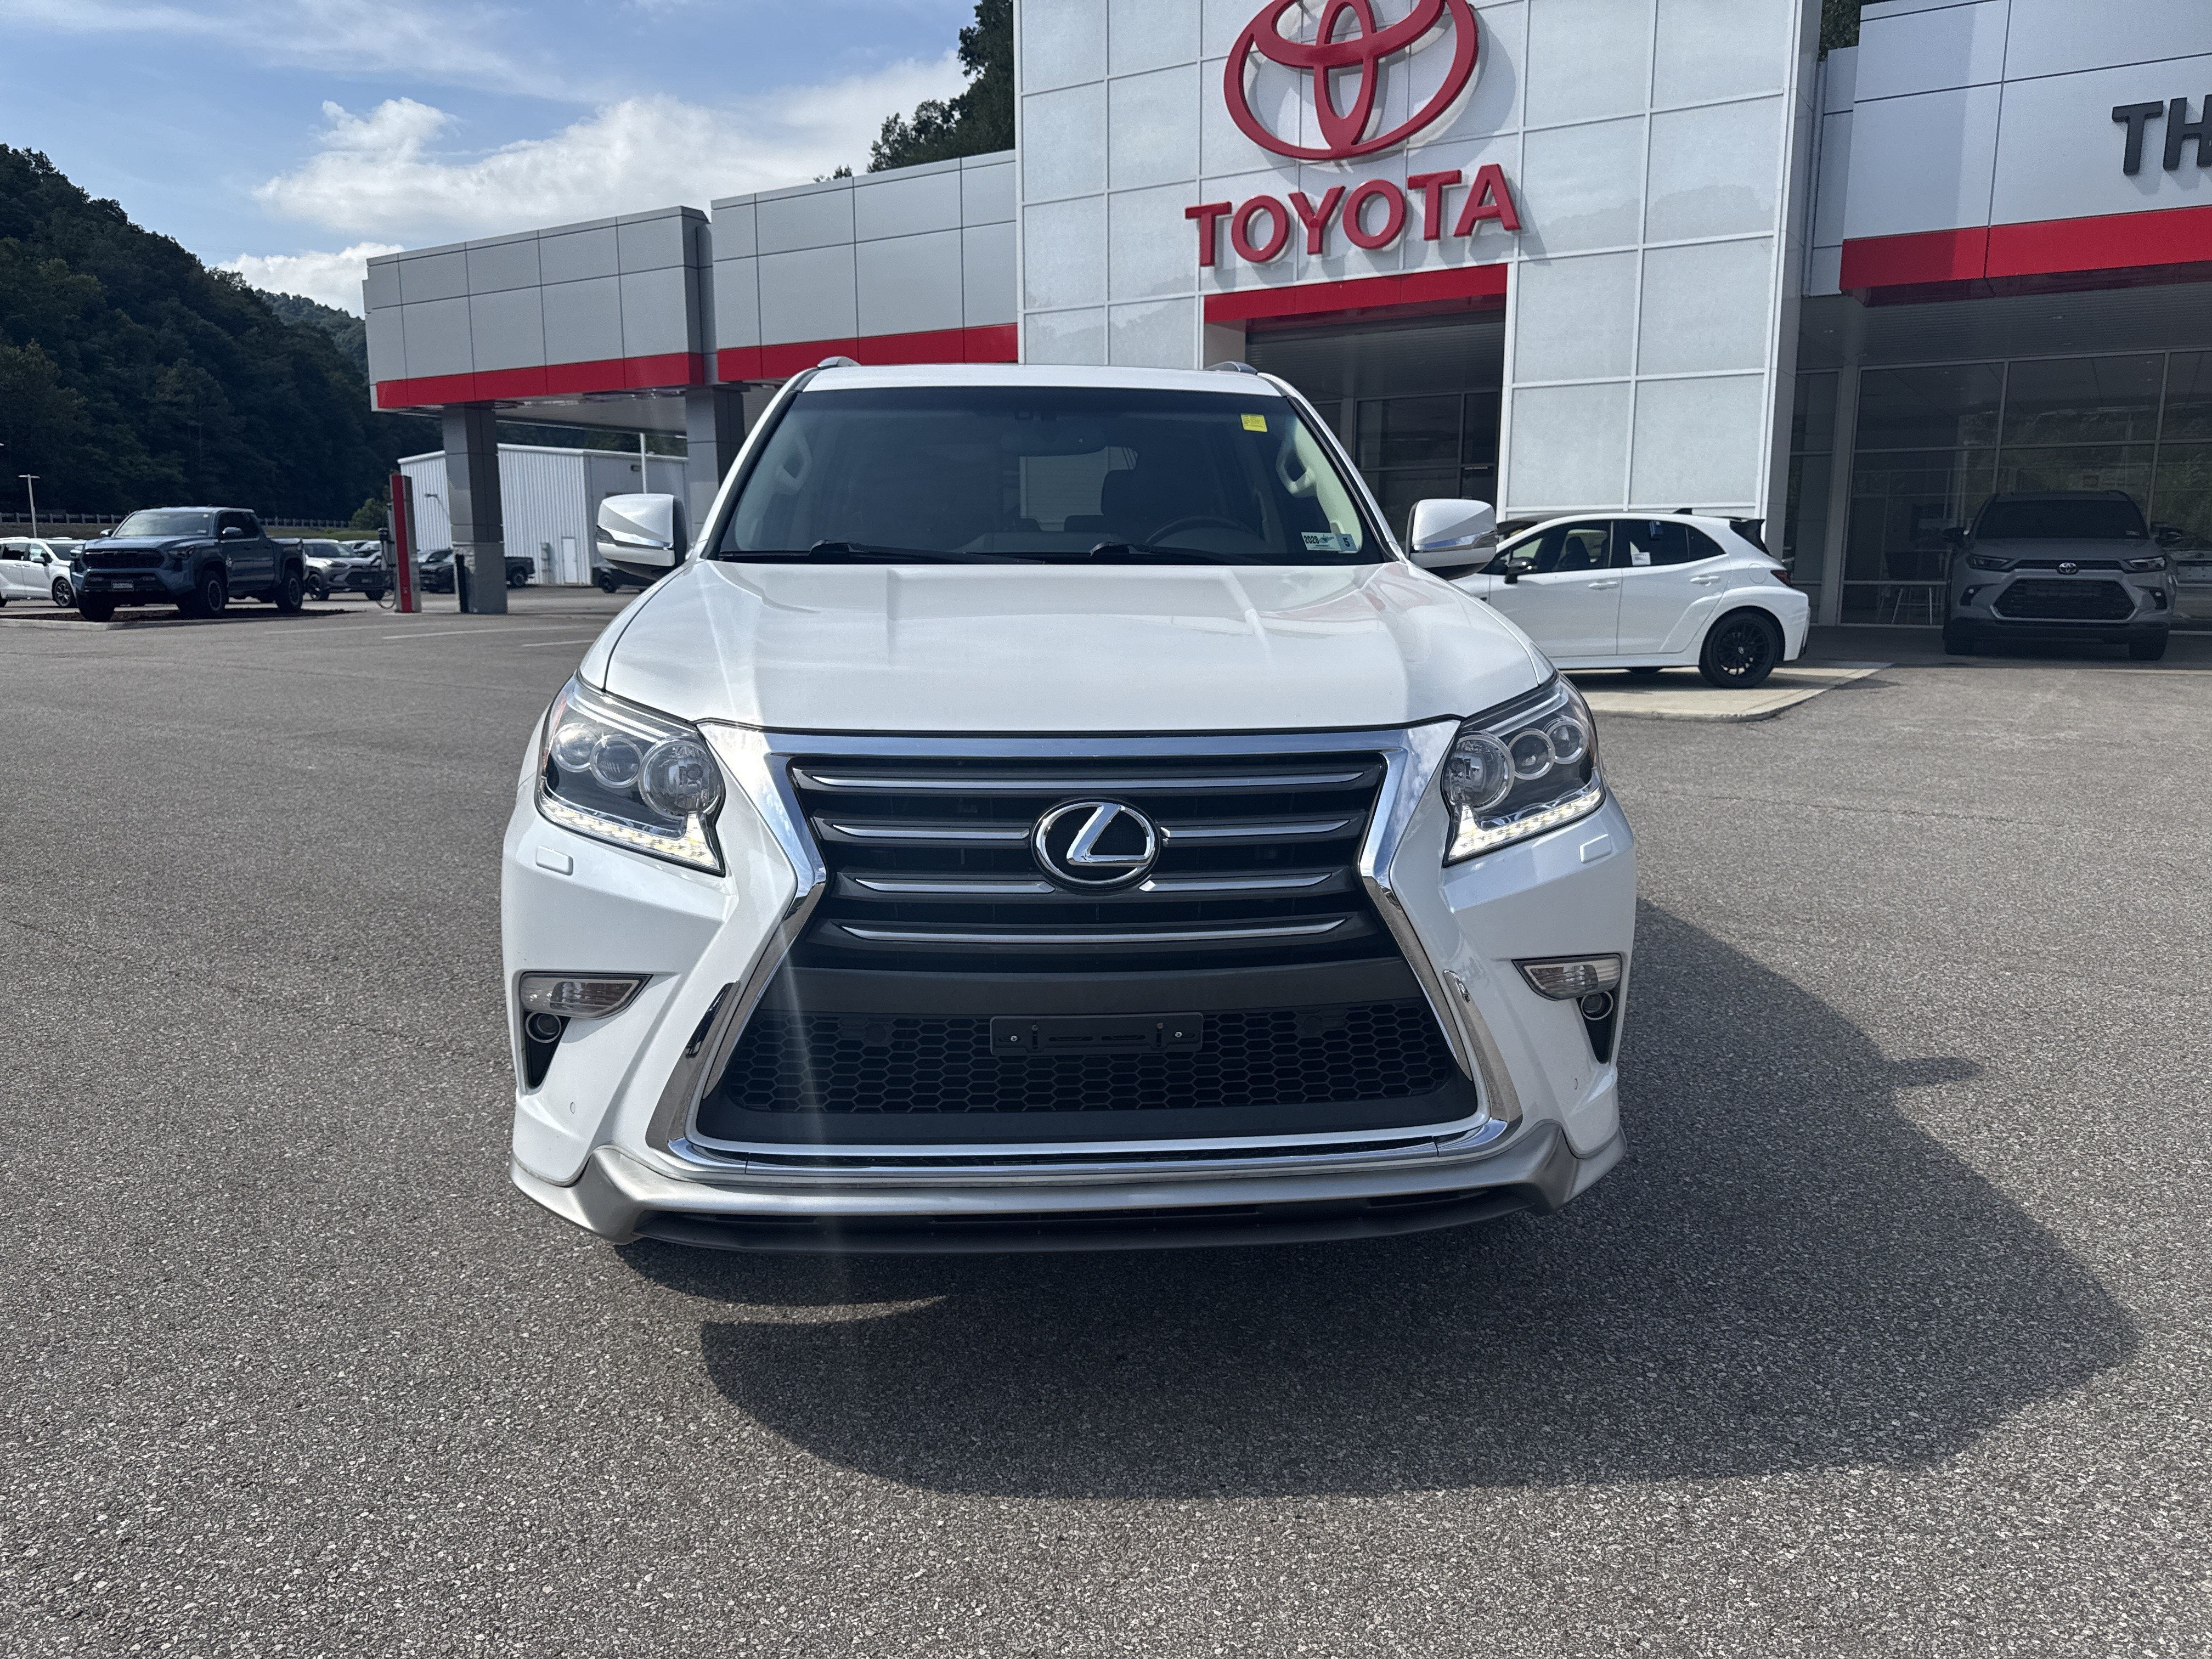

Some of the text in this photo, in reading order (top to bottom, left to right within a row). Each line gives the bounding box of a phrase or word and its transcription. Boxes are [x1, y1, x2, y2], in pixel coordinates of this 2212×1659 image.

[2112, 94, 2212, 176] TH
[1185, 163, 1521, 267] TOYOTA
[1342, 537, 1350, 547] 5
